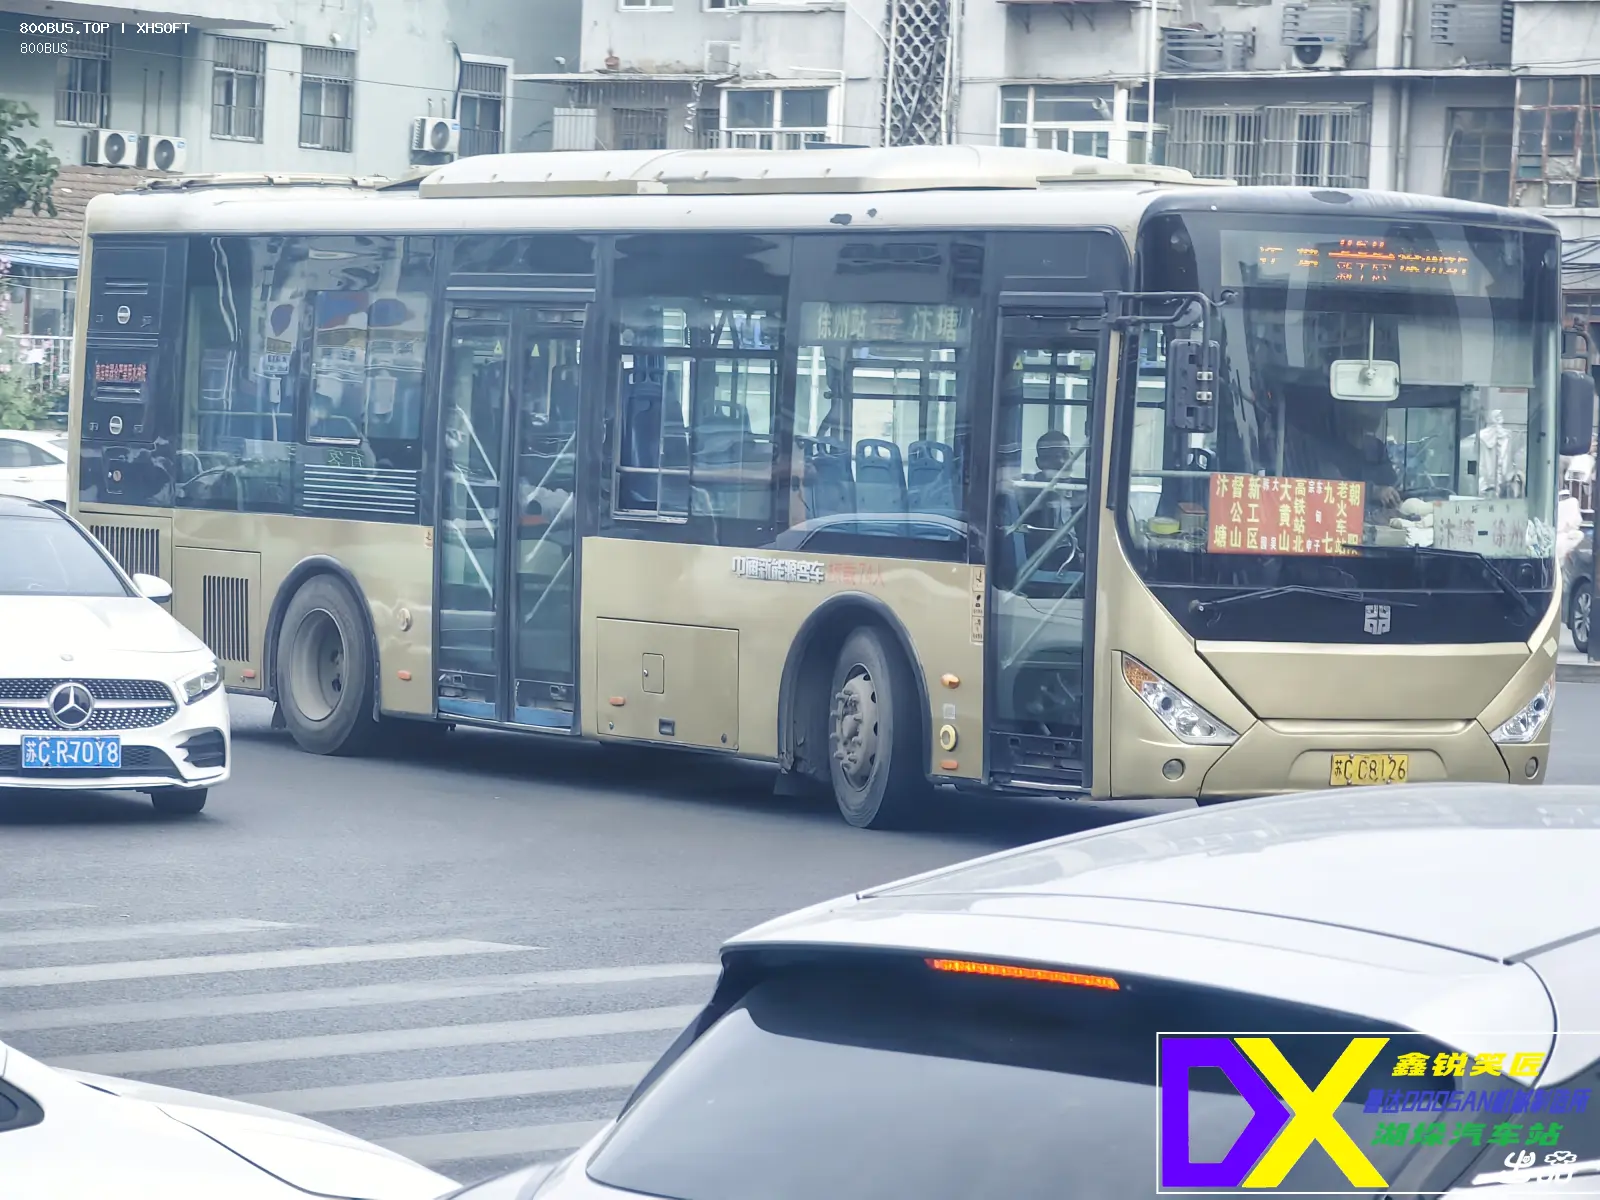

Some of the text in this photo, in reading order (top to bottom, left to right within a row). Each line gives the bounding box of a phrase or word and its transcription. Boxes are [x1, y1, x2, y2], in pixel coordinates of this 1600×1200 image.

[817, 303, 868, 341] 徐州站
[912, 304, 958, 343] 汴塘
[1246, 476, 1262, 549] 新工区
[1278, 478, 1292, 553] 大黄山
[732, 555, 825, 584] 中通新能源客车
